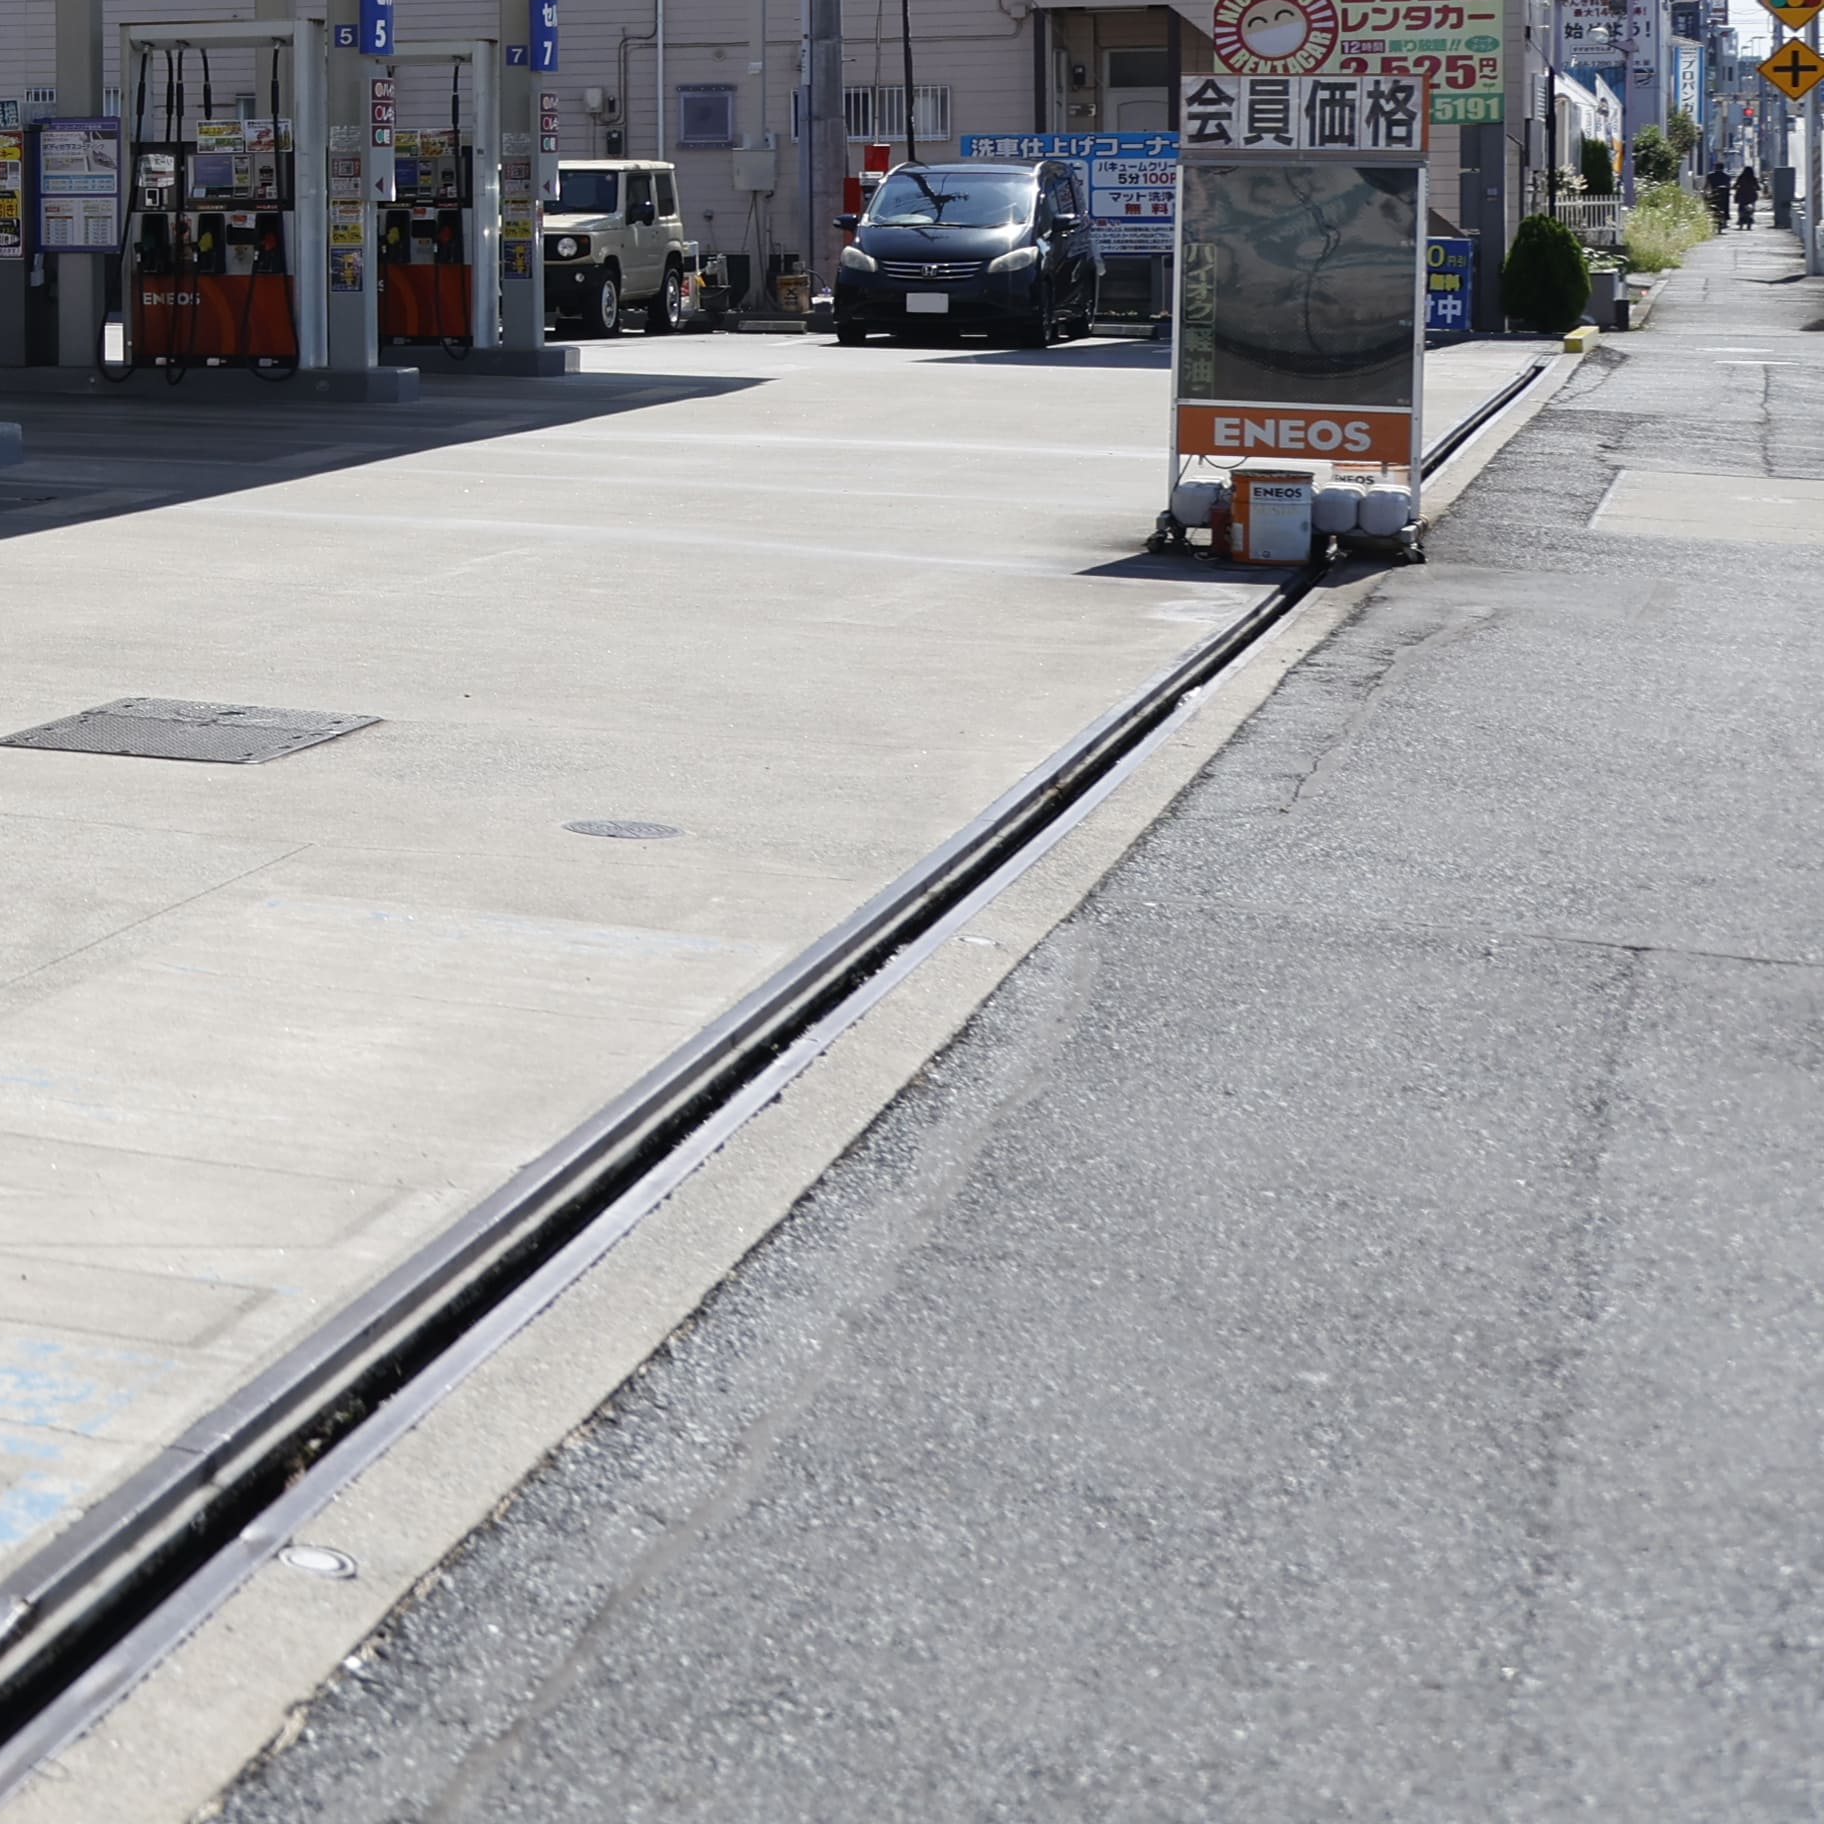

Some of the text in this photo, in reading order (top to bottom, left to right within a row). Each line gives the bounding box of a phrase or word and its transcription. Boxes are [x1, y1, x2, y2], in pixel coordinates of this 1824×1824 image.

[1341, 5, 1495, 32] レンタカー
[339, 28, 353, 45] 5
[375, 20, 386, 49] 5
[1342, 40, 1385, 54] 12時間
[512, 47, 523, 64] 7
[543, 41, 553, 65] 7
[1230, 31, 1332, 73] RENTACAR
[1185, 78, 1418, 147] 会員価格
[1214, 415, 1372, 452] ENEOS
[1254, 487, 1302, 498] ENEOS
